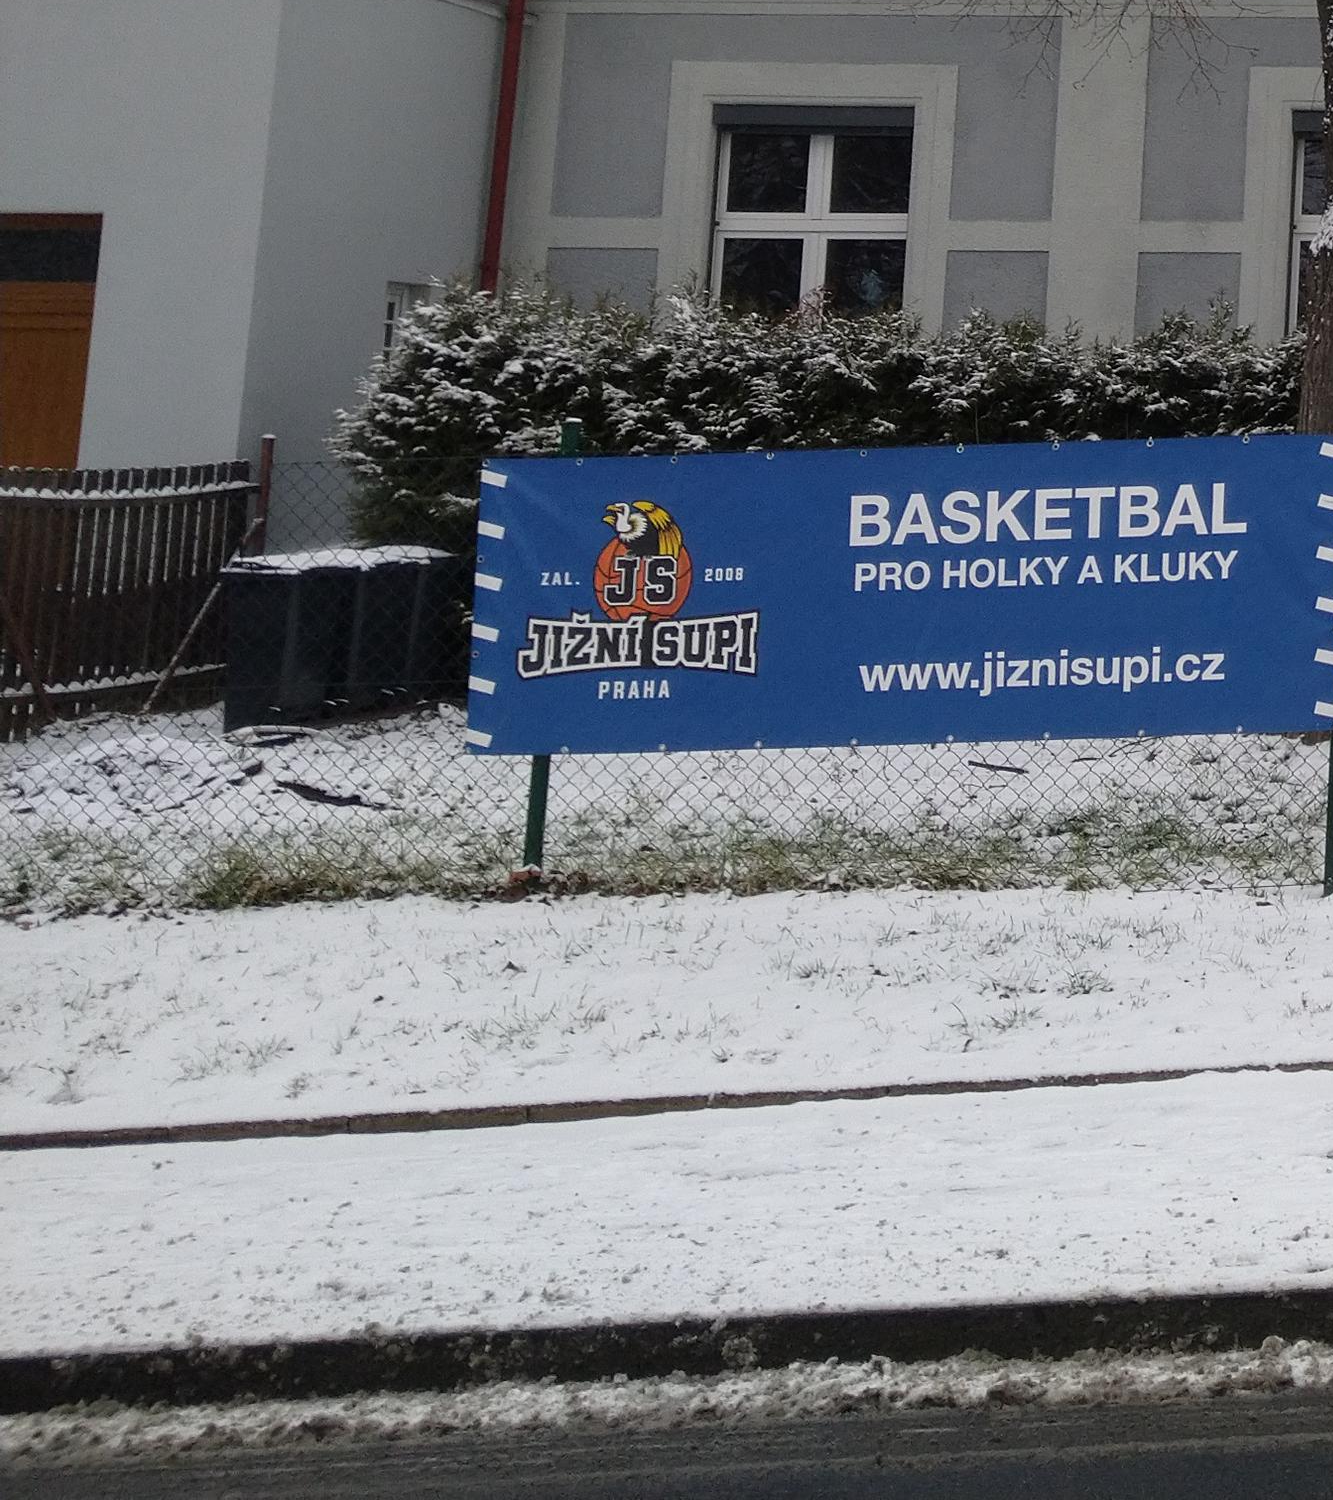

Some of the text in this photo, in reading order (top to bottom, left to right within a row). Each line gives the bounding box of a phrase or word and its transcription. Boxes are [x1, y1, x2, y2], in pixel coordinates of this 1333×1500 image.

[849, 483, 1247, 547] BASKETBAL
[541, 572, 580, 586] ZAL.
[604, 555, 677, 606] JS
[704, 567, 744, 582] 2008
[854, 550, 1239, 592] PRO HOLKY A KLUKY
[518, 612, 758, 678] JIŽNÍ SUPI
[598, 680, 670, 699] PRAHA
[859, 646, 1225, 696] www.jiznisupi.cz
